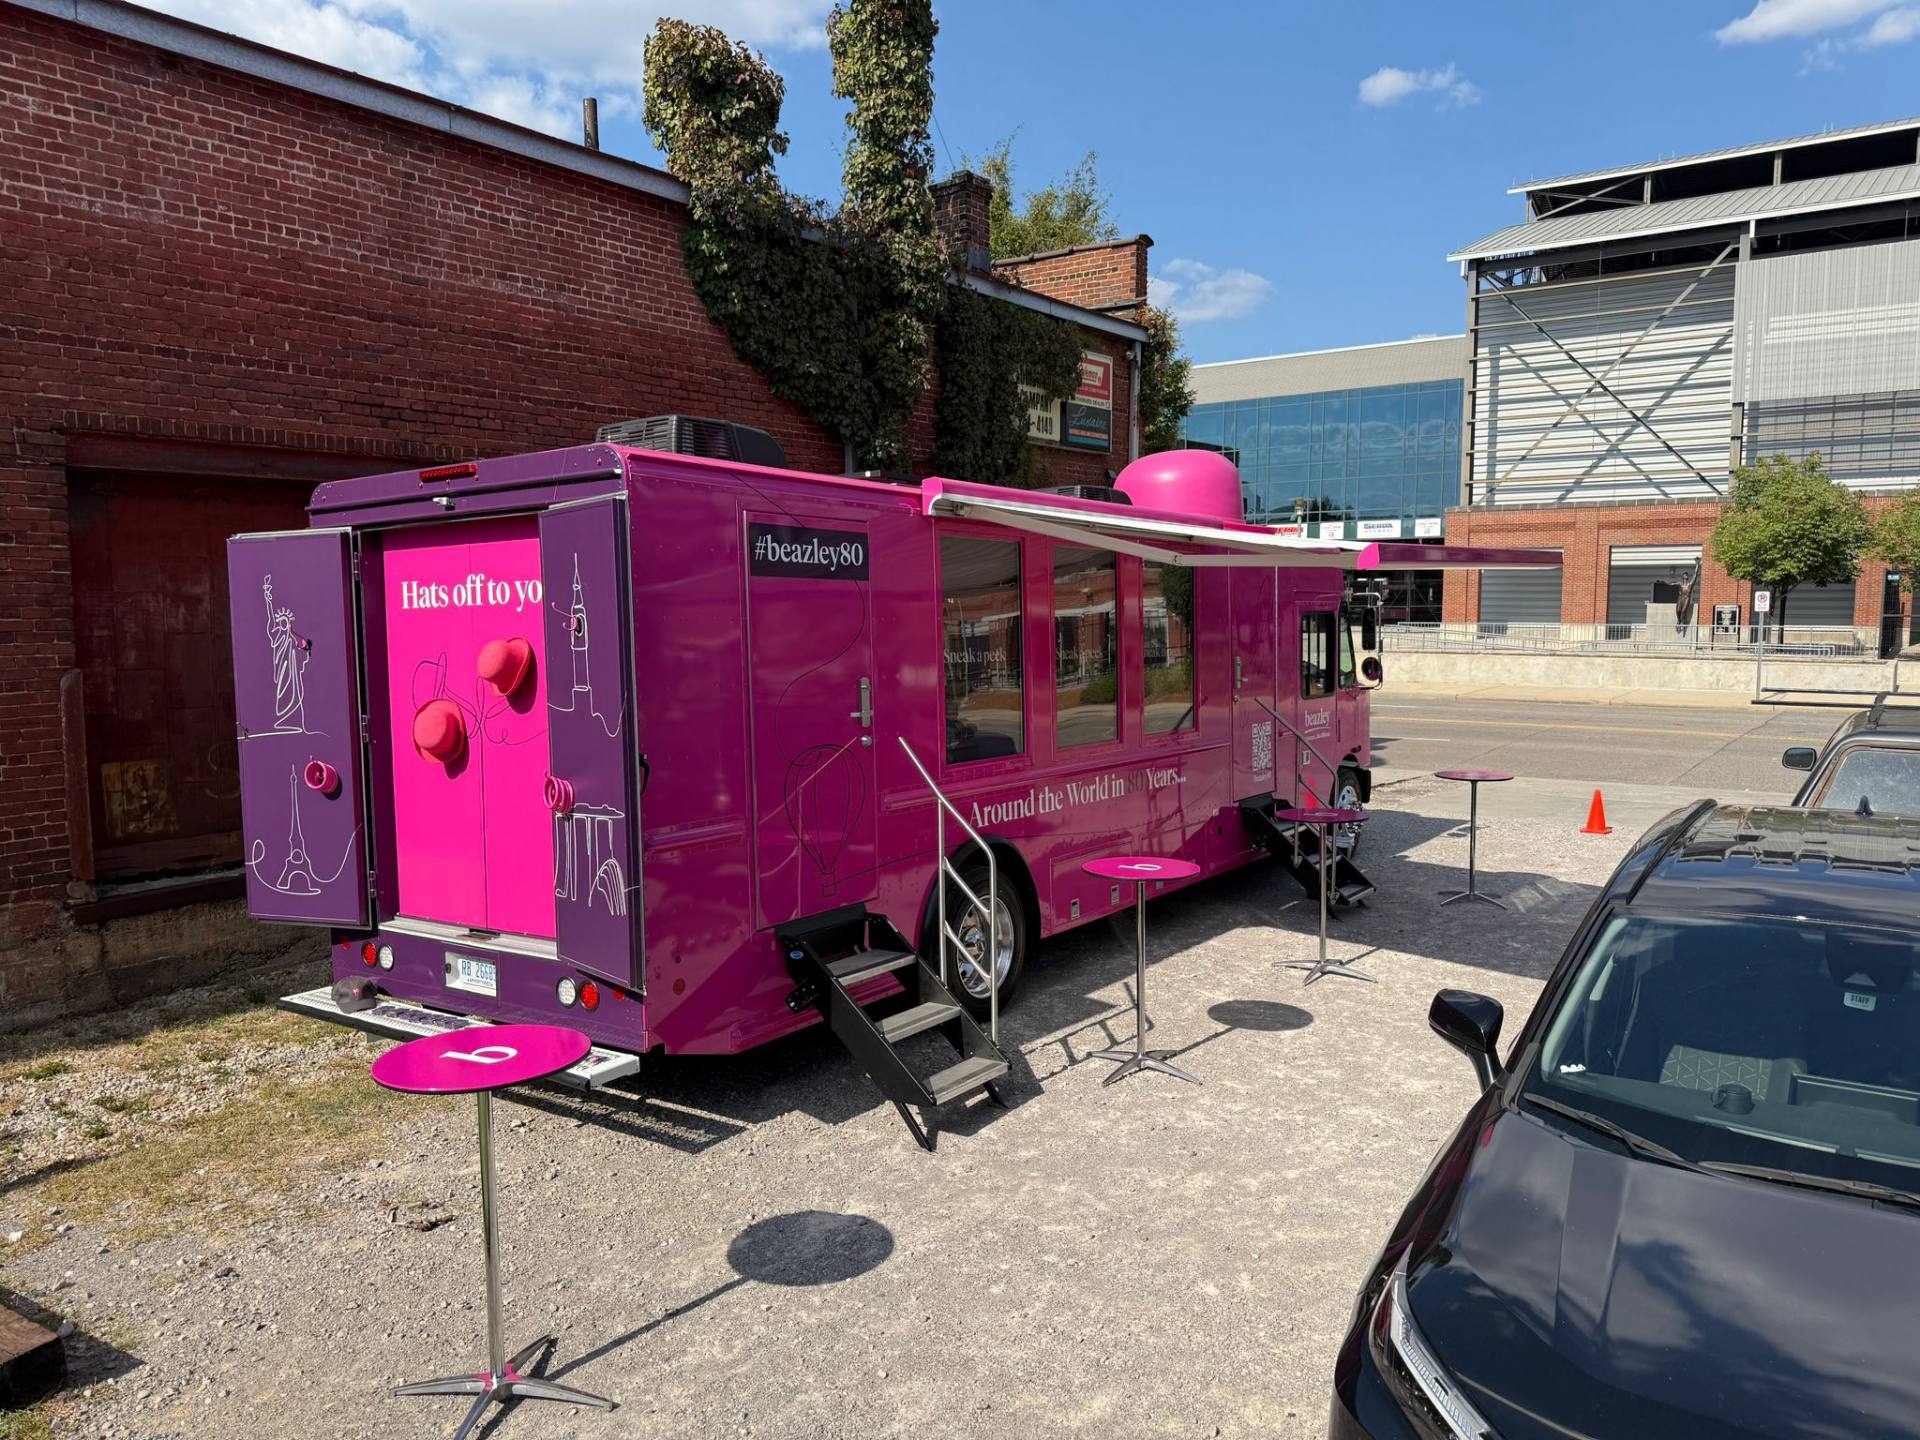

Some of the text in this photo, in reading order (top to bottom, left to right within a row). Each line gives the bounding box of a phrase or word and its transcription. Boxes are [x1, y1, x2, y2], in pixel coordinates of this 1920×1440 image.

[754, 534, 864, 571] #beazley80
[401, 581, 449, 609] Hats
[452, 573, 486, 607] off
[488, 578, 511, 605] to
[943, 647, 976, 663] Sneak
[983, 648, 1007, 666] peek
[1304, 707, 1331, 727] beazley
[969, 789, 1035, 828] Around
[1039, 786, 1064, 815] the
[1066, 777, 1109, 807] World
[1111, 774, 1125, 798] in
[1128, 774, 1144, 793] 80
